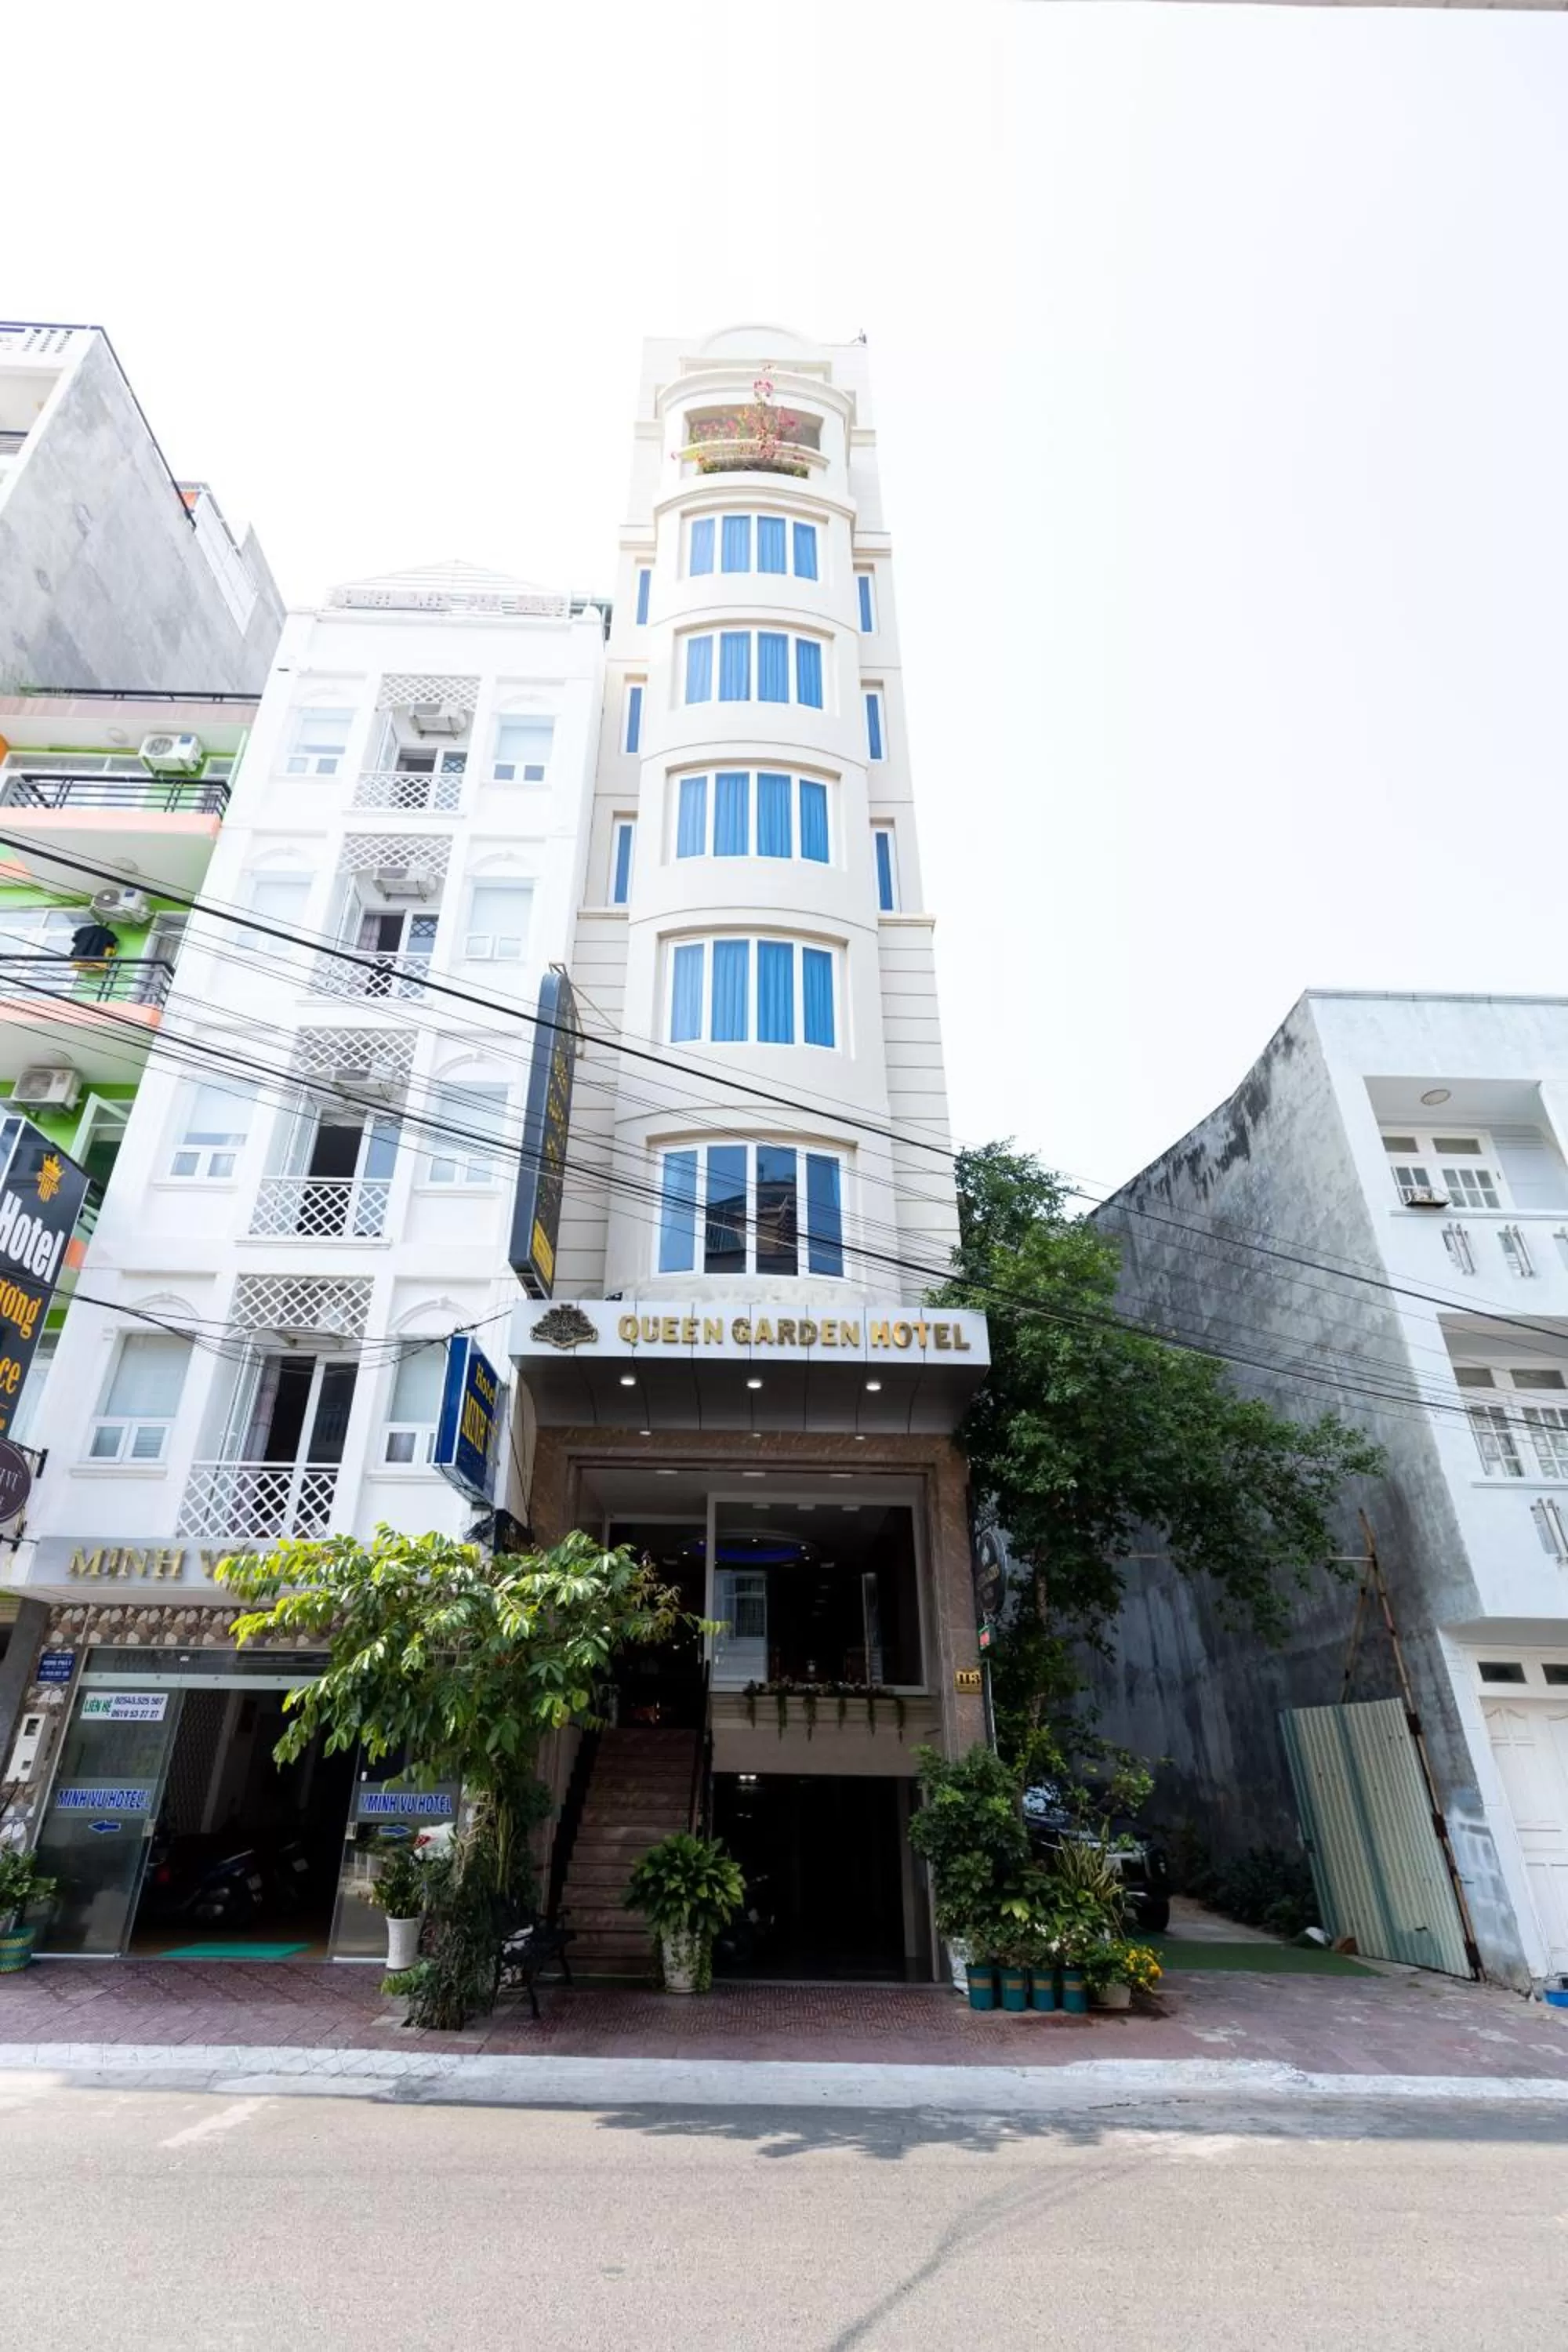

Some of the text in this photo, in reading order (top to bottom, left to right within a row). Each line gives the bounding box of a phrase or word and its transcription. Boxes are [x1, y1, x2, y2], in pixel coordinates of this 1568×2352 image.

[0, 1189, 65, 1283] Hotel
[617, 1315, 971, 1351] QUEEN GARDEN HOTEL
[68, 1546, 187, 1579] MINH
[959, 1674, 980, 1685] 113
[57, 1788, 89, 1809] MINH
[366, 1793, 398, 1813] MINH
[418, 1794, 452, 1815] HOTEL
